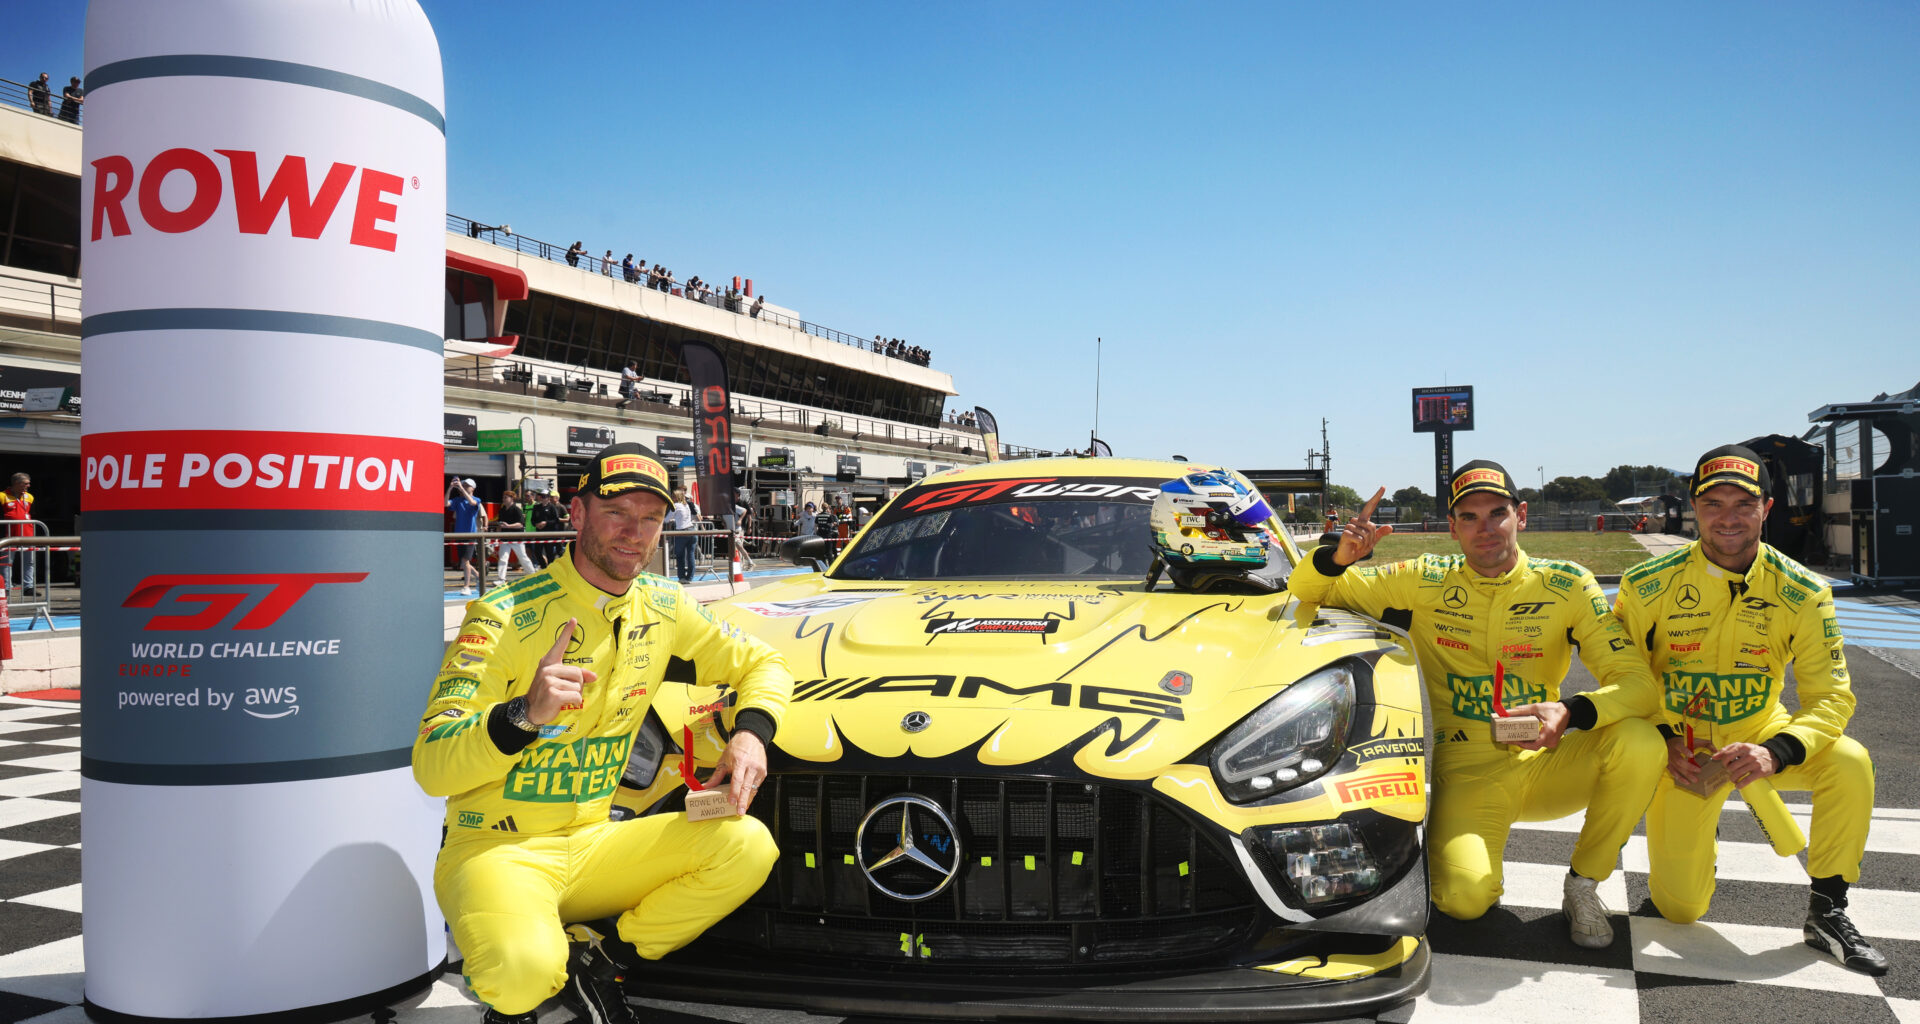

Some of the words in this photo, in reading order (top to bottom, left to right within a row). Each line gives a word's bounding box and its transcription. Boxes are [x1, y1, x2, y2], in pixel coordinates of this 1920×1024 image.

[90, 147, 404, 252] ROWE
[85, 453, 167, 491] POLE
[178, 452, 415, 493] POSITION
[606, 457, 665, 481] PIRELLI
[1703, 458, 1755, 476] PIRELLI
[1455, 470, 1501, 491] PIRELLI
[1550, 576, 1573, 589] OMP
[1638, 580, 1661, 596] OMP
[1782, 586, 1806, 602] OMP
[514, 610, 537, 627] OMP
[131, 642, 204, 659] WORLD
[210, 639, 341, 659] CHALLENGE
[1502, 644, 1532, 653] ROWE
[118, 664, 192, 678] EUROPE
[1670, 673, 1766, 698] MANN
[118, 688, 200, 710] powered
[207, 688, 234, 710] by
[244, 686, 298, 705] aws
[689, 702, 724, 716] ROWE
[519, 738, 626, 769] MANN
[1363, 742, 1423, 758] RAVENOL
[513, 765, 620, 796] FILTER
[1334, 772, 1419, 804] PIRELLI
[458, 813, 484, 826] OMP
[700, 806, 726, 818] AWARD
